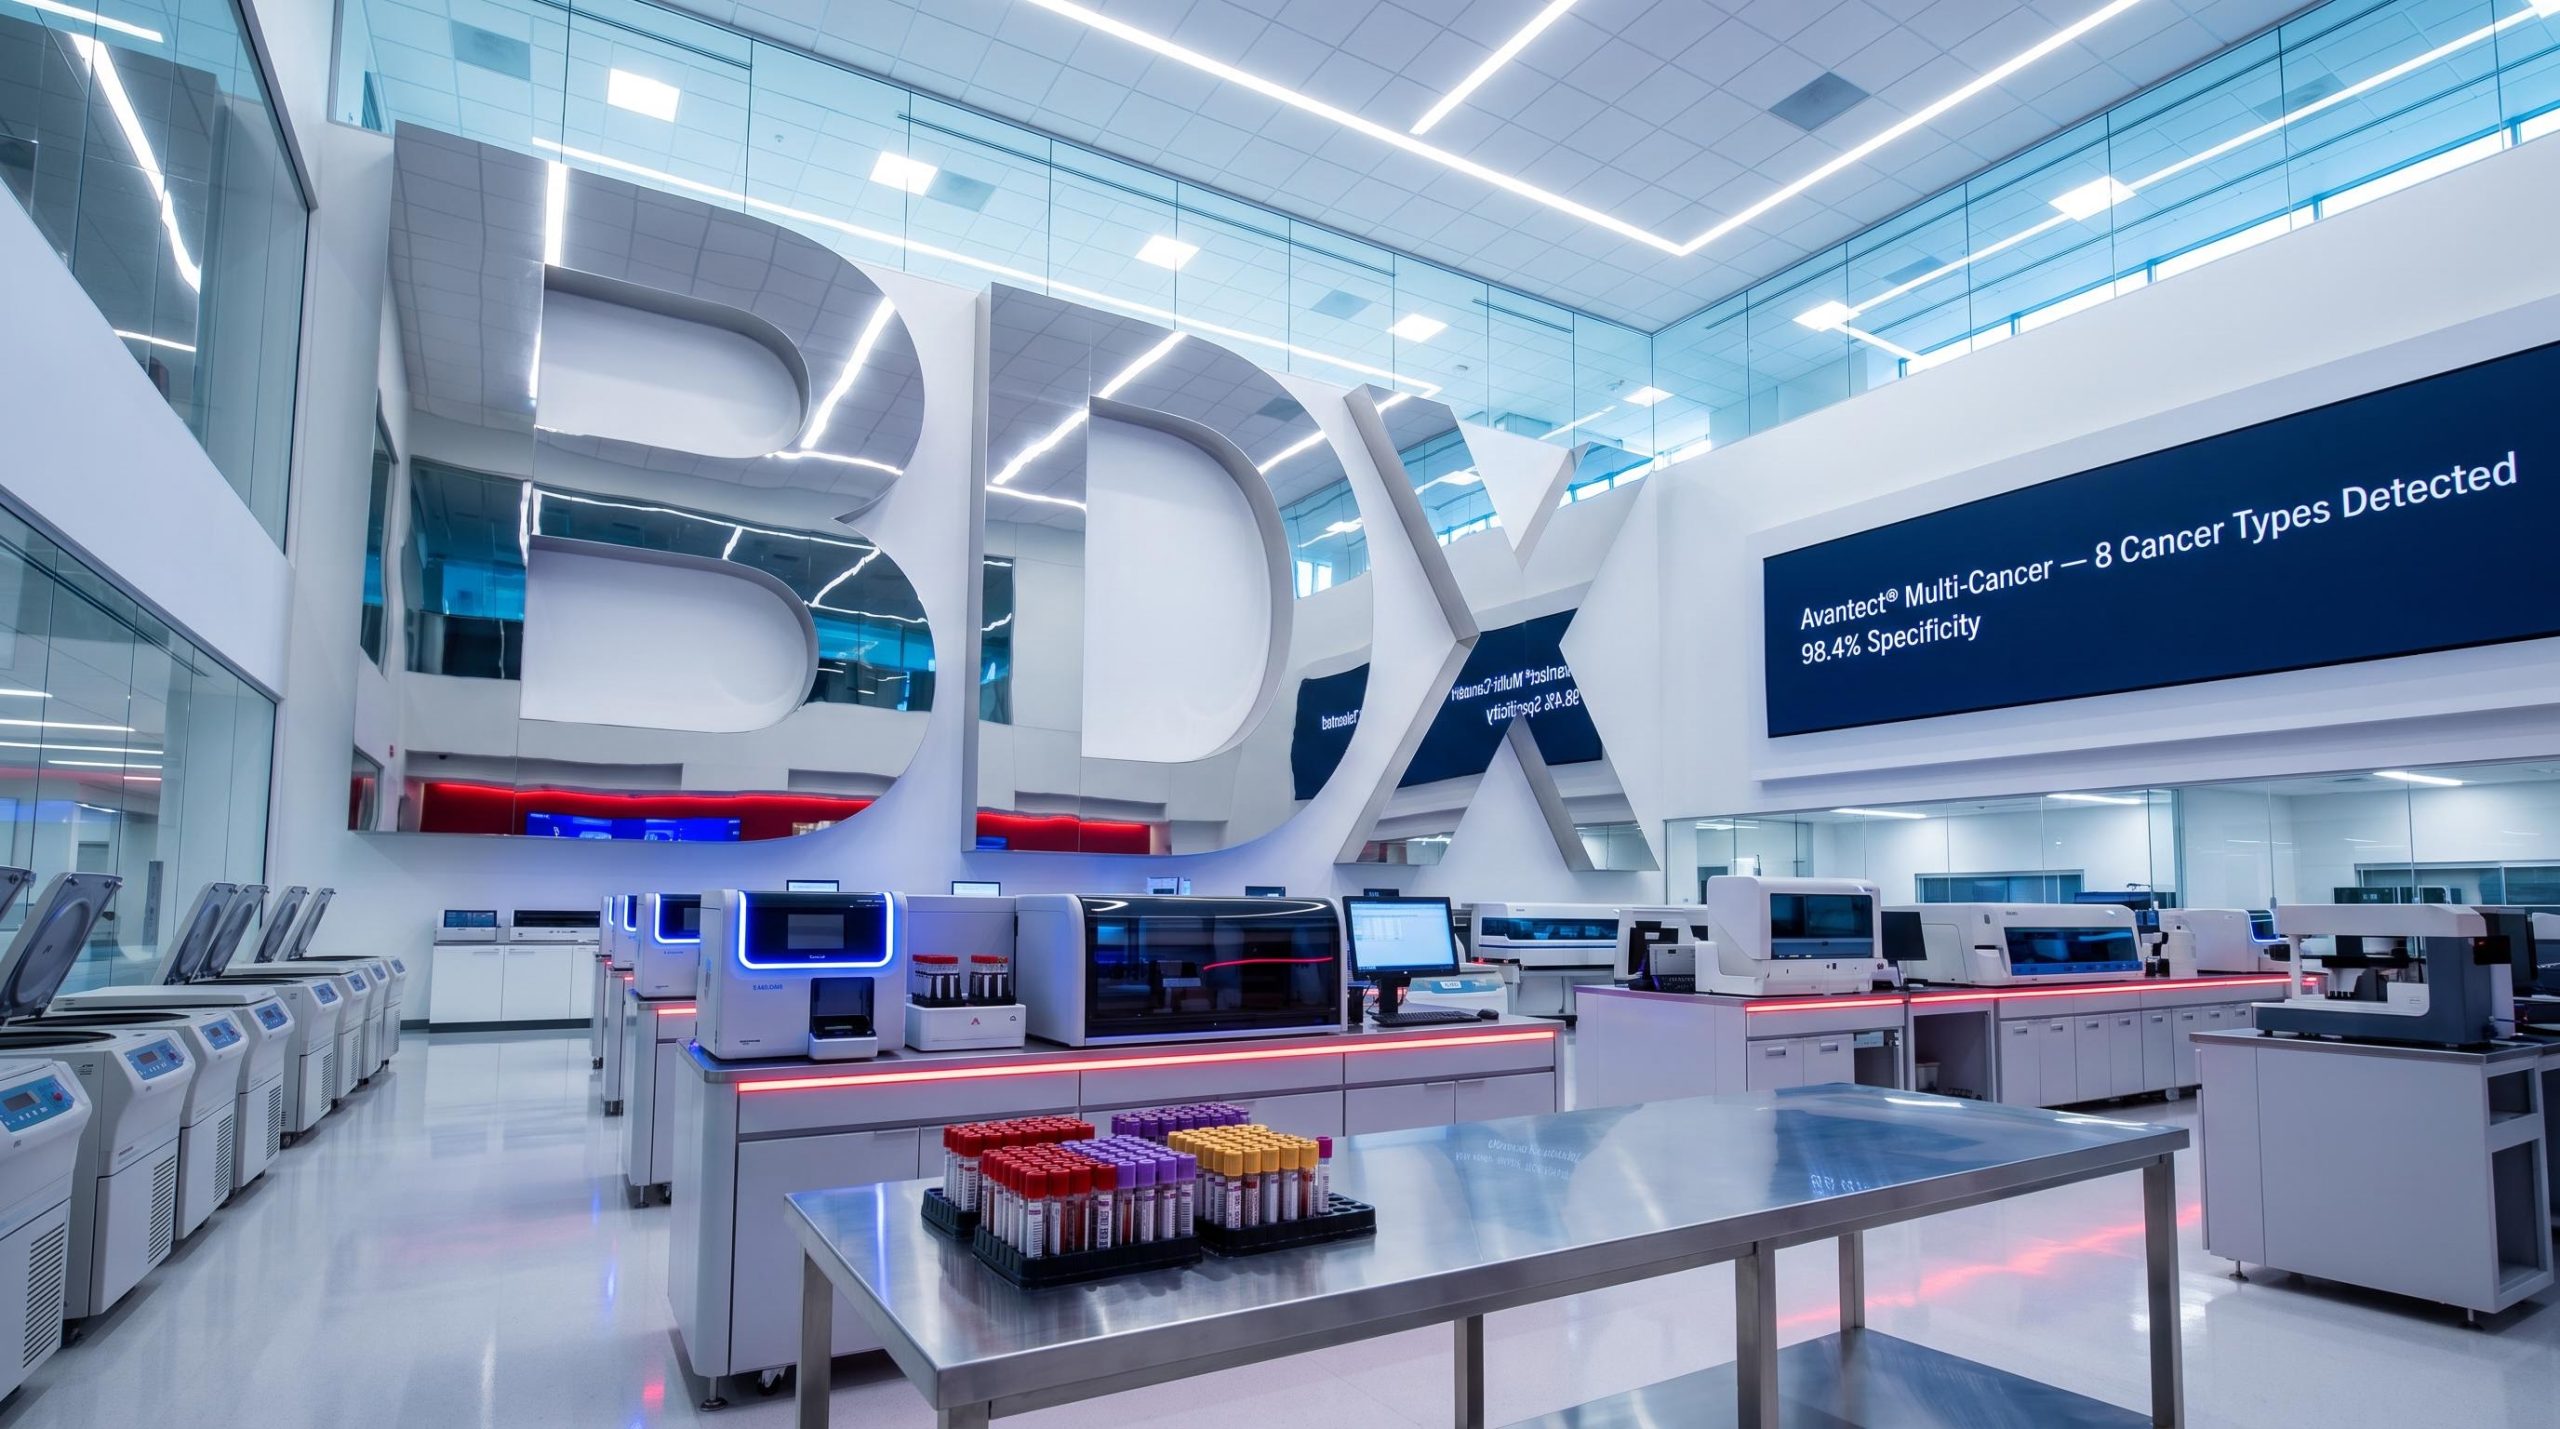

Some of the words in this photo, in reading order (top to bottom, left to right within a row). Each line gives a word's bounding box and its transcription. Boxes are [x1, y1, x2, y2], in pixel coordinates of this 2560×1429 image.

[347, 121, 1662, 872] BDX
[1800, 588, 1899, 631] Avantect®
[1905, 559, 2055, 608] Multi-Cancer
[2095, 541, 2114, 569] 8
[2120, 521, 2226, 563] Cancer
[2232, 500, 2332, 545] Types
[2342, 450, 2517, 518] Detected
[1800, 633, 1862, 665] 98.4%
[1867, 613, 1982, 657] Specificity
